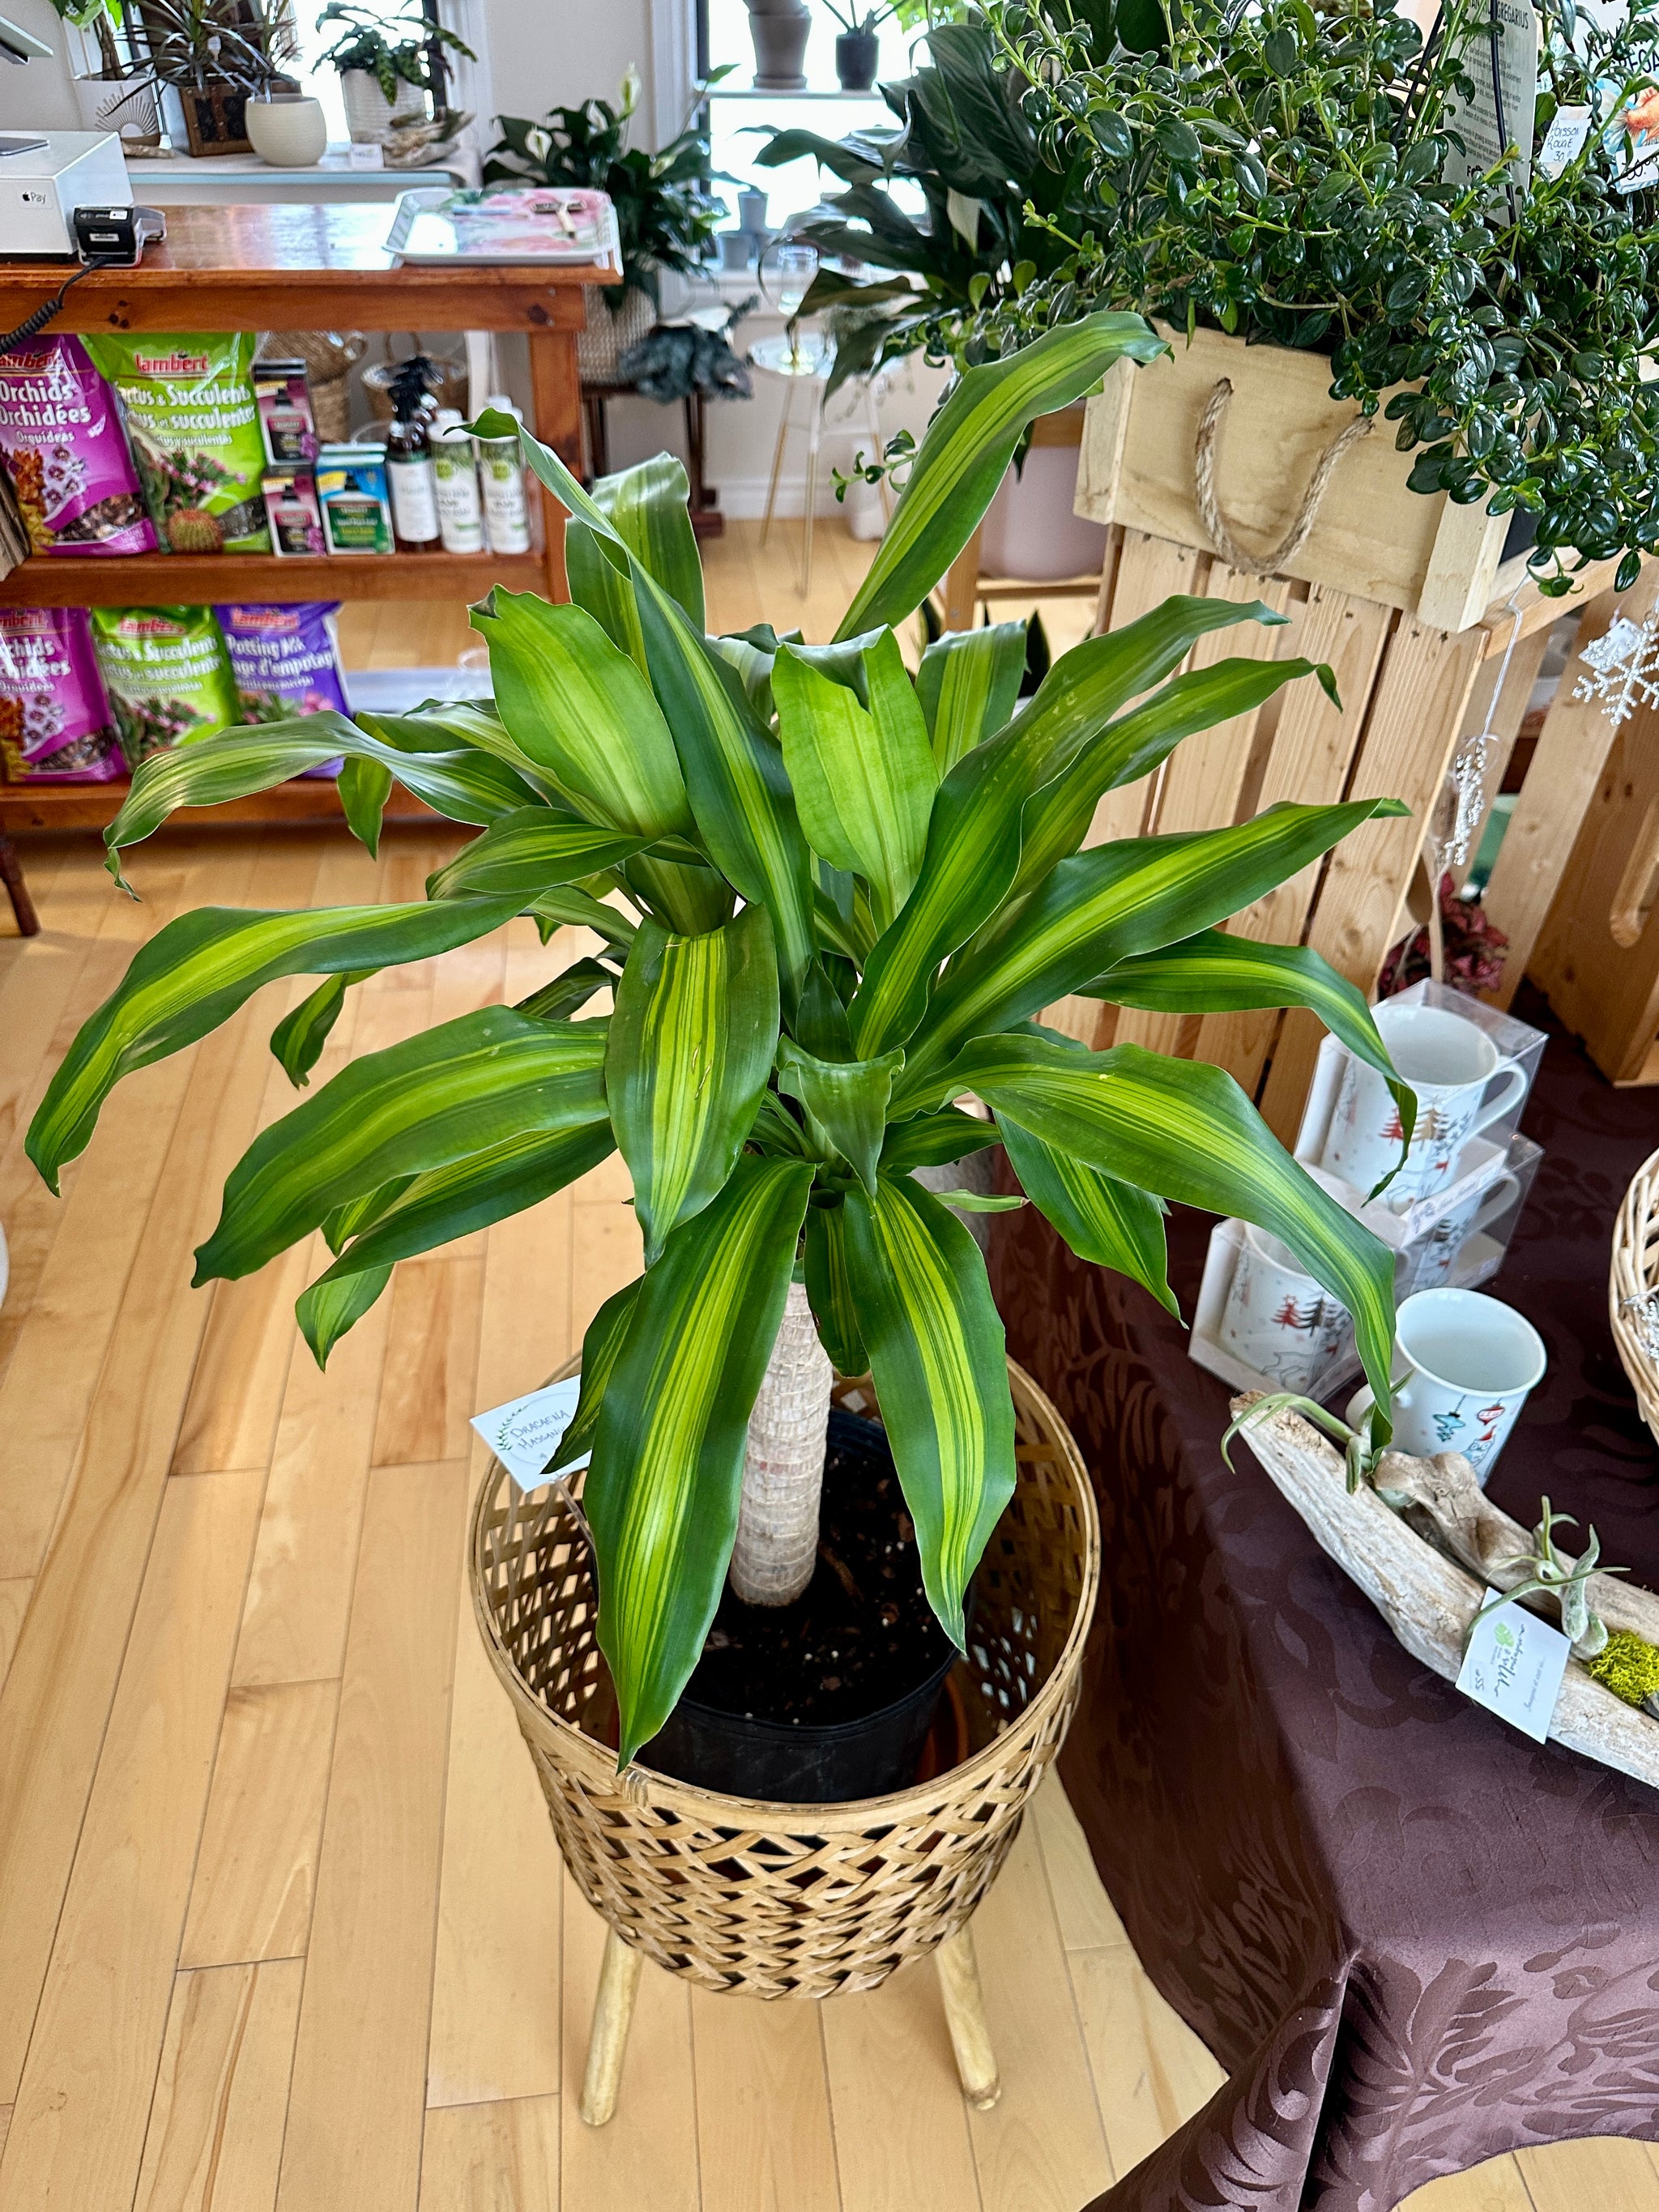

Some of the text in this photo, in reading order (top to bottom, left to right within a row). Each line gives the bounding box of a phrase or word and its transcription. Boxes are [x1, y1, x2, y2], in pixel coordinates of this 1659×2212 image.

[1497, 1, 1529, 30] GREGARIUS
[1550, 120, 1580, 138] POISSON
[1546, 137, 1573, 151] ROUGE
[31, 192, 46, 203] Pay
[134, 352, 211, 373] lambert
[0, 379, 74, 403] Orchids
[0, 403, 92, 427] Orchidées
[510, 1409, 572, 1438] DRACAENA
